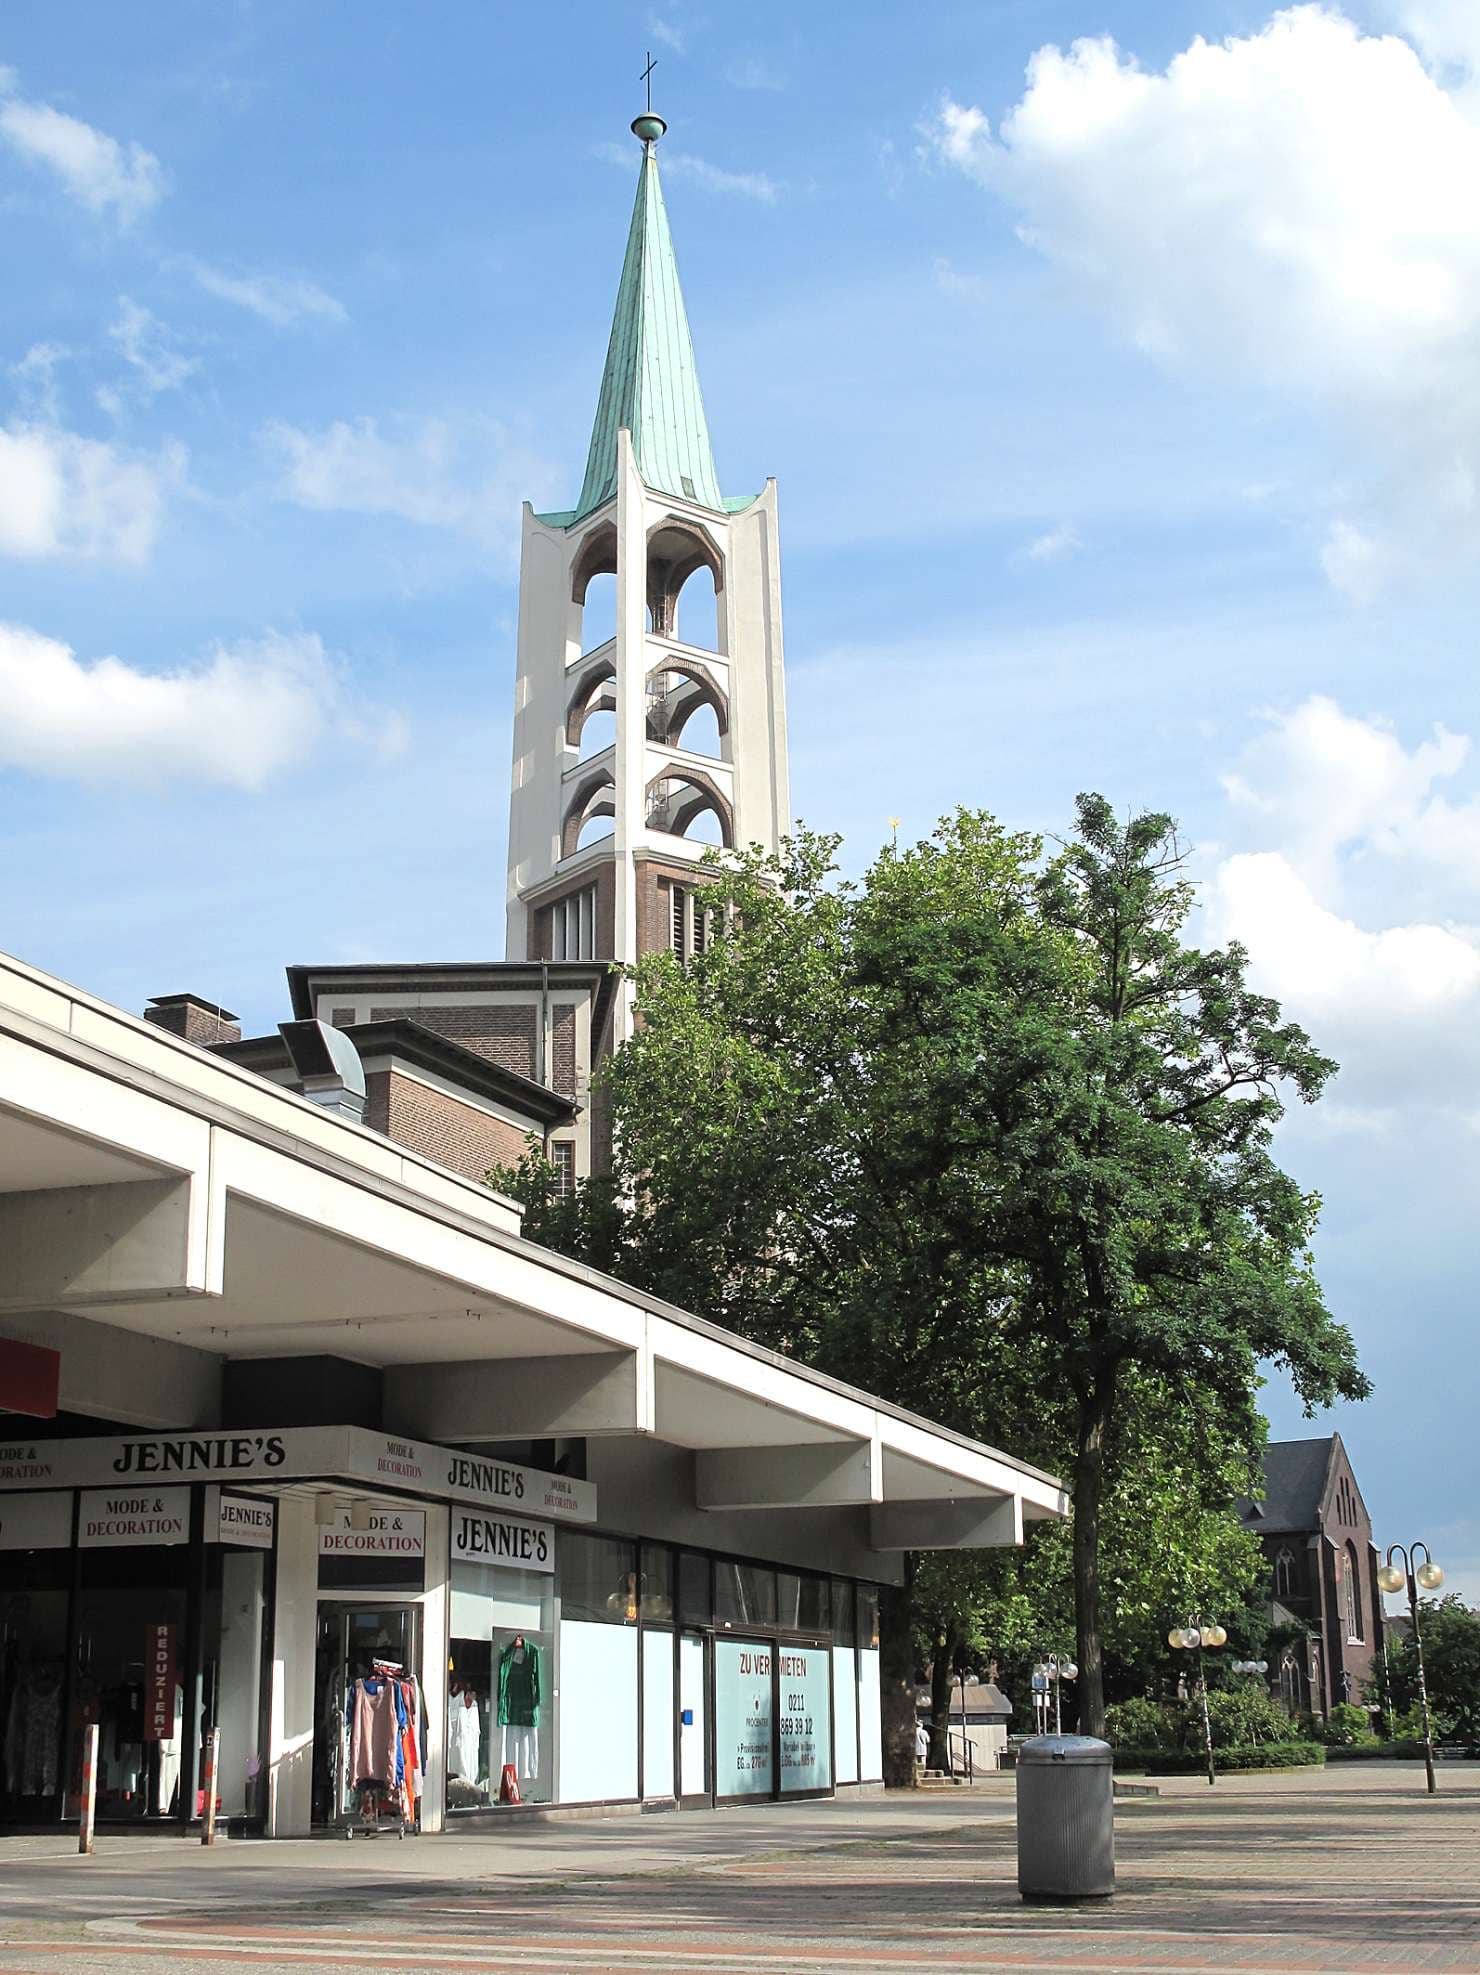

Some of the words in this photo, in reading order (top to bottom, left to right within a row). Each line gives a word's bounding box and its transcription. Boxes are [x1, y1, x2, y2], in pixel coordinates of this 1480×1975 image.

[113, 1436, 286, 1473] JENNIE'S
[376, 1457, 422, 1478] DECORATION
[448, 1457, 525, 1499] JENNIE'S
[106, 1499, 149, 1514] MODE
[152, 1499, 164, 1513] &
[221, 1505, 272, 1527] JENNIE'S
[87, 1519, 183, 1536] DECORATION
[343, 1515, 388, 1530] MDE
[392, 1516, 403, 1530] &
[323, 1535, 423, 1551] DECORATION
[456, 1516, 548, 1562] JENNIE'S
[740, 1653, 752, 1674] ZU
[153, 1625, 169, 1737] REDUZIERT
[788, 1694, 805, 1712] 0211
[780, 1717, 794, 1735] 869
[794, 1717, 803, 1735] 39
[805, 1717, 813, 1735] 12
